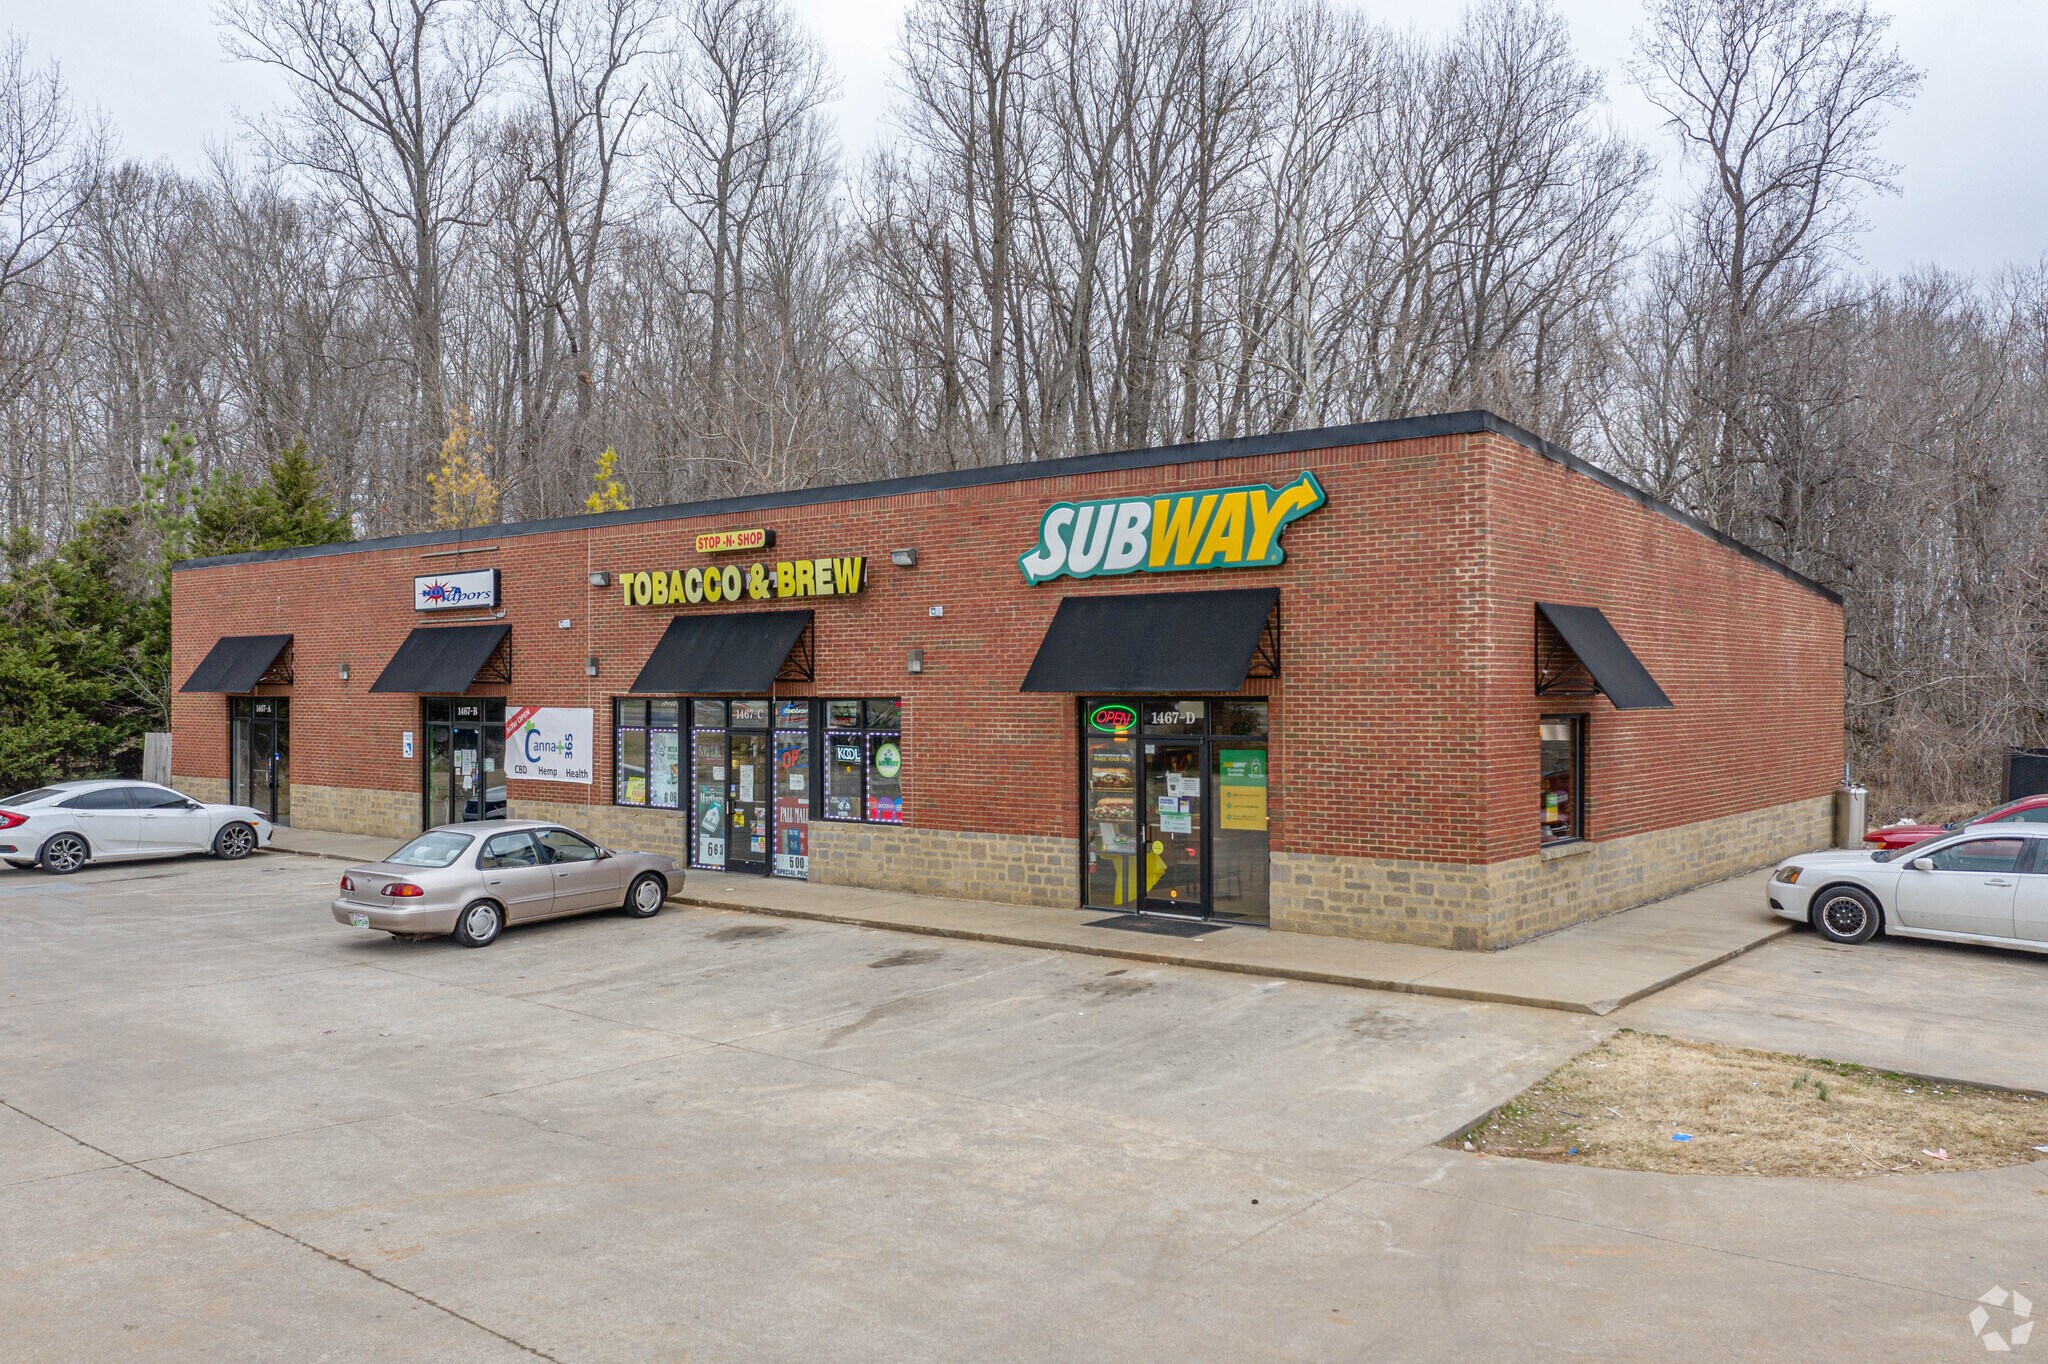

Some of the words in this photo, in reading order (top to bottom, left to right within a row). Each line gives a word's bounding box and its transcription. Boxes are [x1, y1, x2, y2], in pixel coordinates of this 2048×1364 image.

[1022, 478, 1317, 580] SUBWAY
[698, 536, 721, 550] STOP
[737, 532, 763, 546] SHOP
[619, 564, 743, 606] TOBACCO
[749, 562, 772, 600] &
[776, 557, 864, 598] BREW
[457, 706, 479, 716] 1467-B
[735, 709, 764, 720] 1467-C
[1096, 710, 1131, 726] OPEN
[1151, 711, 1195, 724] 1467-D
[506, 720, 518, 735] NOW
[516, 708, 532, 723] OPEN
[564, 733, 574, 760] 365
[837, 746, 860, 760] KOOL
[514, 764, 528, 775] CBD
[538, 766, 558, 778] Hemp
[565, 768, 589, 779] Health
[780, 806, 793, 823] PALL
